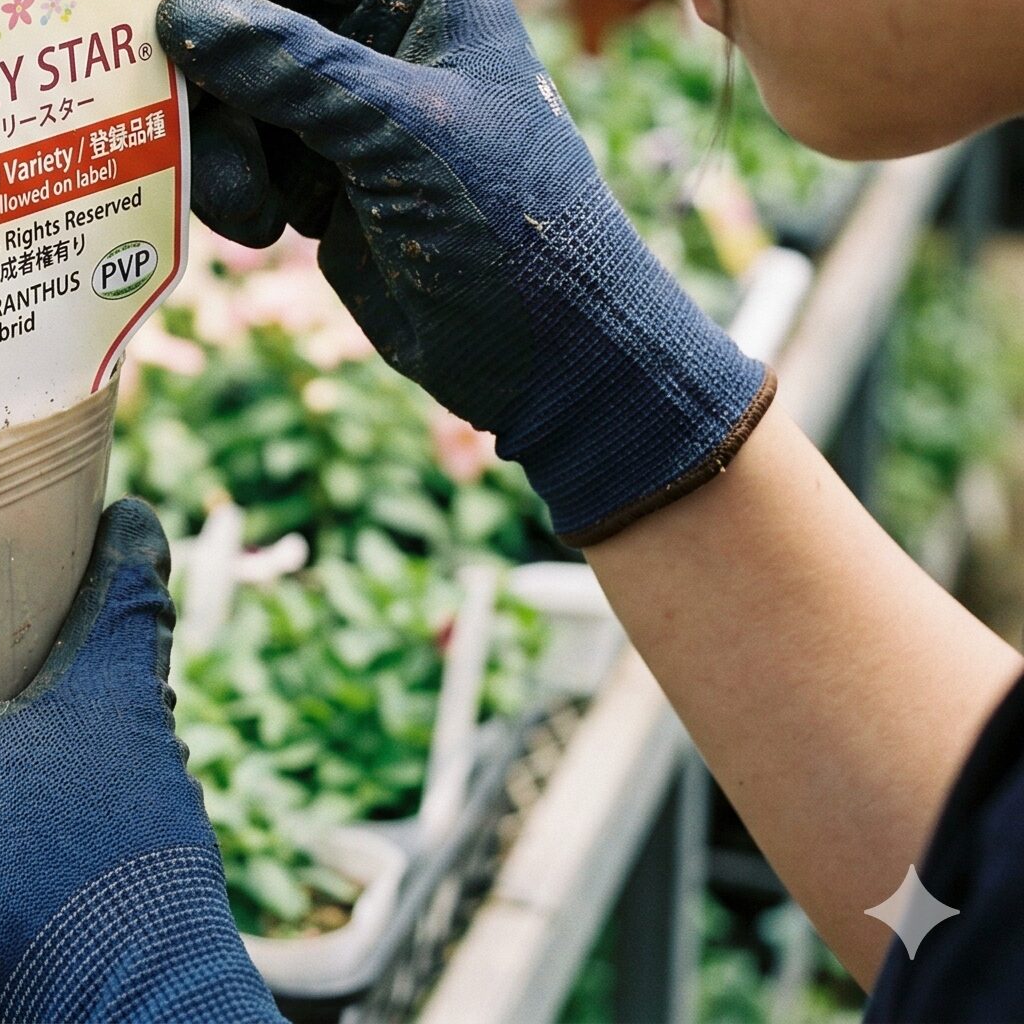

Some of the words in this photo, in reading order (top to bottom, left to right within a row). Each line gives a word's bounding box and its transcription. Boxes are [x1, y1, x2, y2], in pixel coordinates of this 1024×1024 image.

[4, 143, 74, 184] Variety
[77, 136, 85, 164] /
[89, 109, 167, 160] 登録品種
[53, 176, 73, 196] on
[76, 158, 118, 186] label)
[5, 219, 61, 250] Rights
[64, 186, 143, 231] Reserved
[101, 249, 150, 290] PVP
